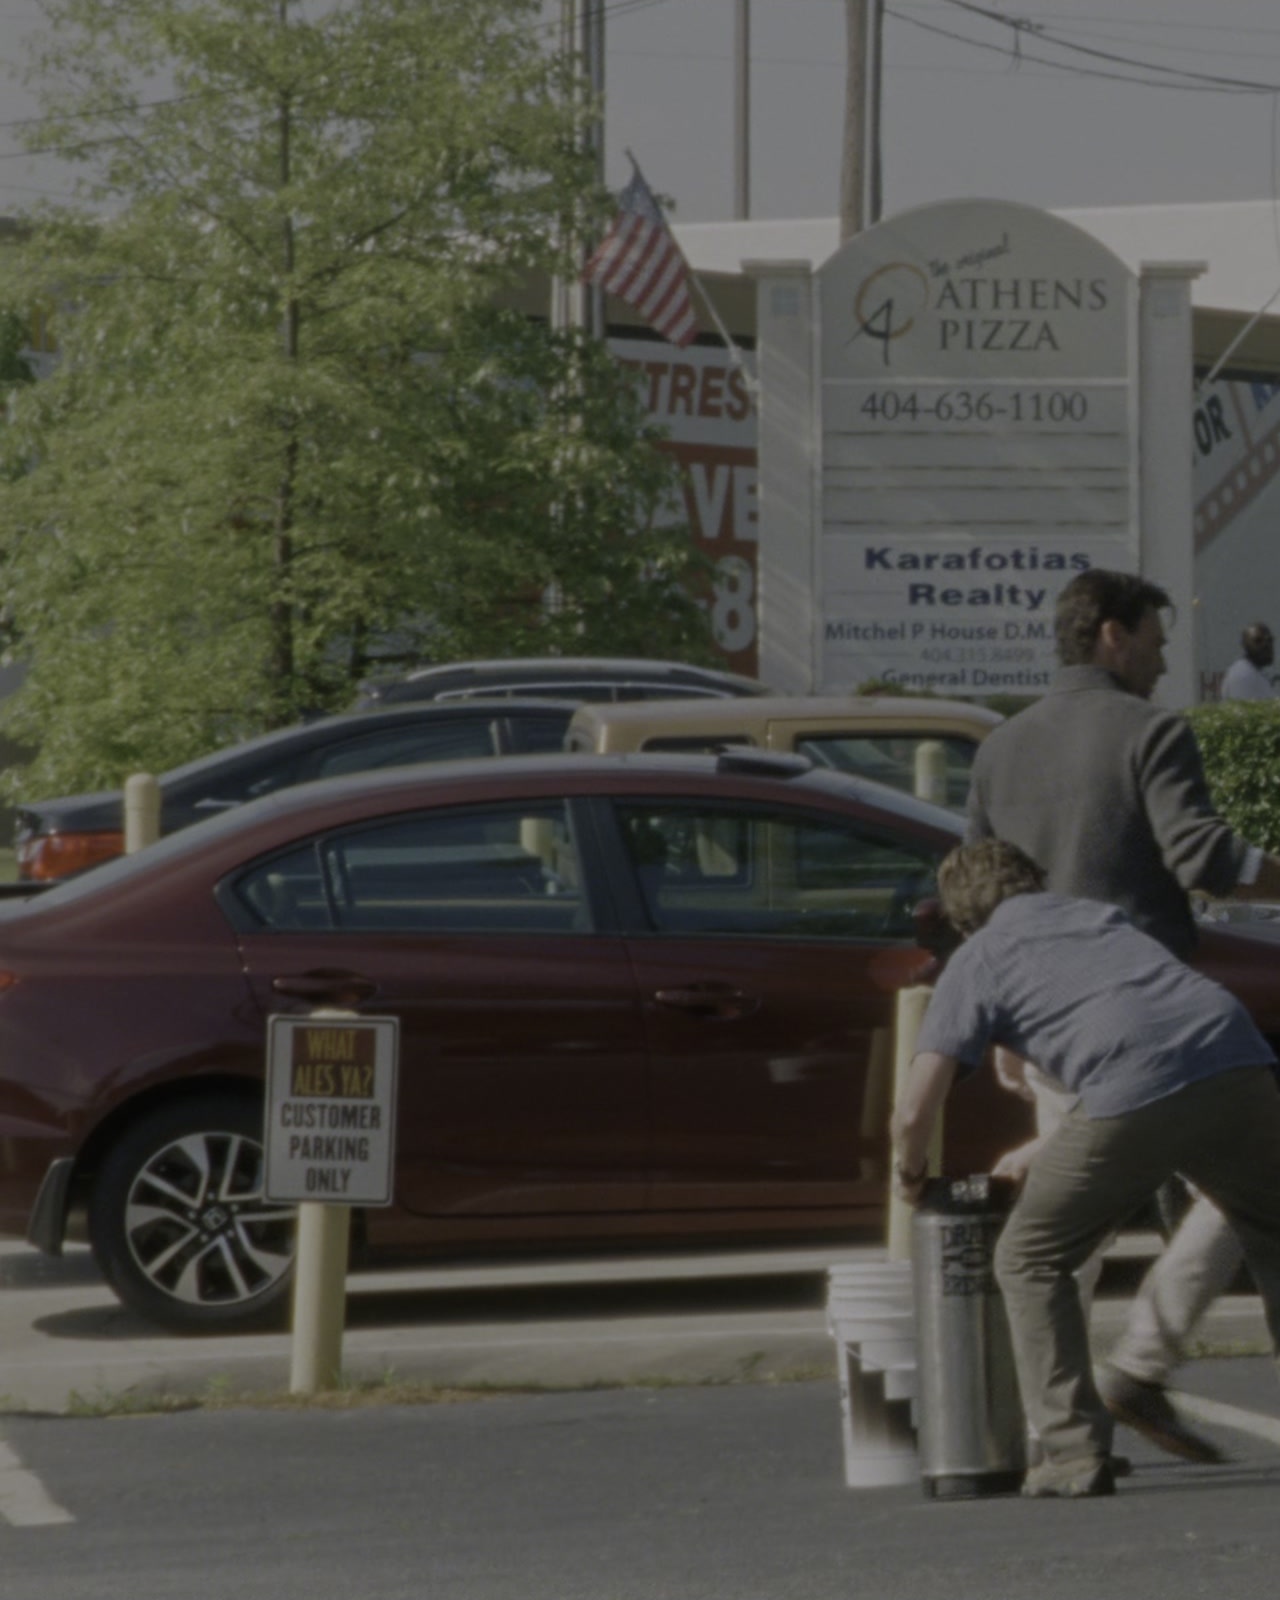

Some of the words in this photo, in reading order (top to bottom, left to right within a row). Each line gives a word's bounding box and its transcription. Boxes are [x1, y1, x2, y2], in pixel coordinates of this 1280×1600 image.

[936, 278, 1108, 311] ATHENS
[940, 319, 1060, 351] PIZZA
[860, 390, 1088, 422] 404-636-1100
[864, 546, 1092, 572] Karafotias
[908, 582, 1046, 611] Realty
[825, 622, 906, 641] Mitchel
[912, 623, 926, 641] P
[931, 624, 997, 641] House
[882, 668, 967, 686] General
[973, 668, 1050, 686] Dentist
[306, 1029, 357, 1061] WHAT
[293, 1063, 336, 1096] ALES
[340, 1066, 373, 1097] YA?
[281, 1103, 381, 1130] CUSTOMER
[289, 1135, 370, 1162] PARKING
[306, 1167, 351, 1192] ONLY
